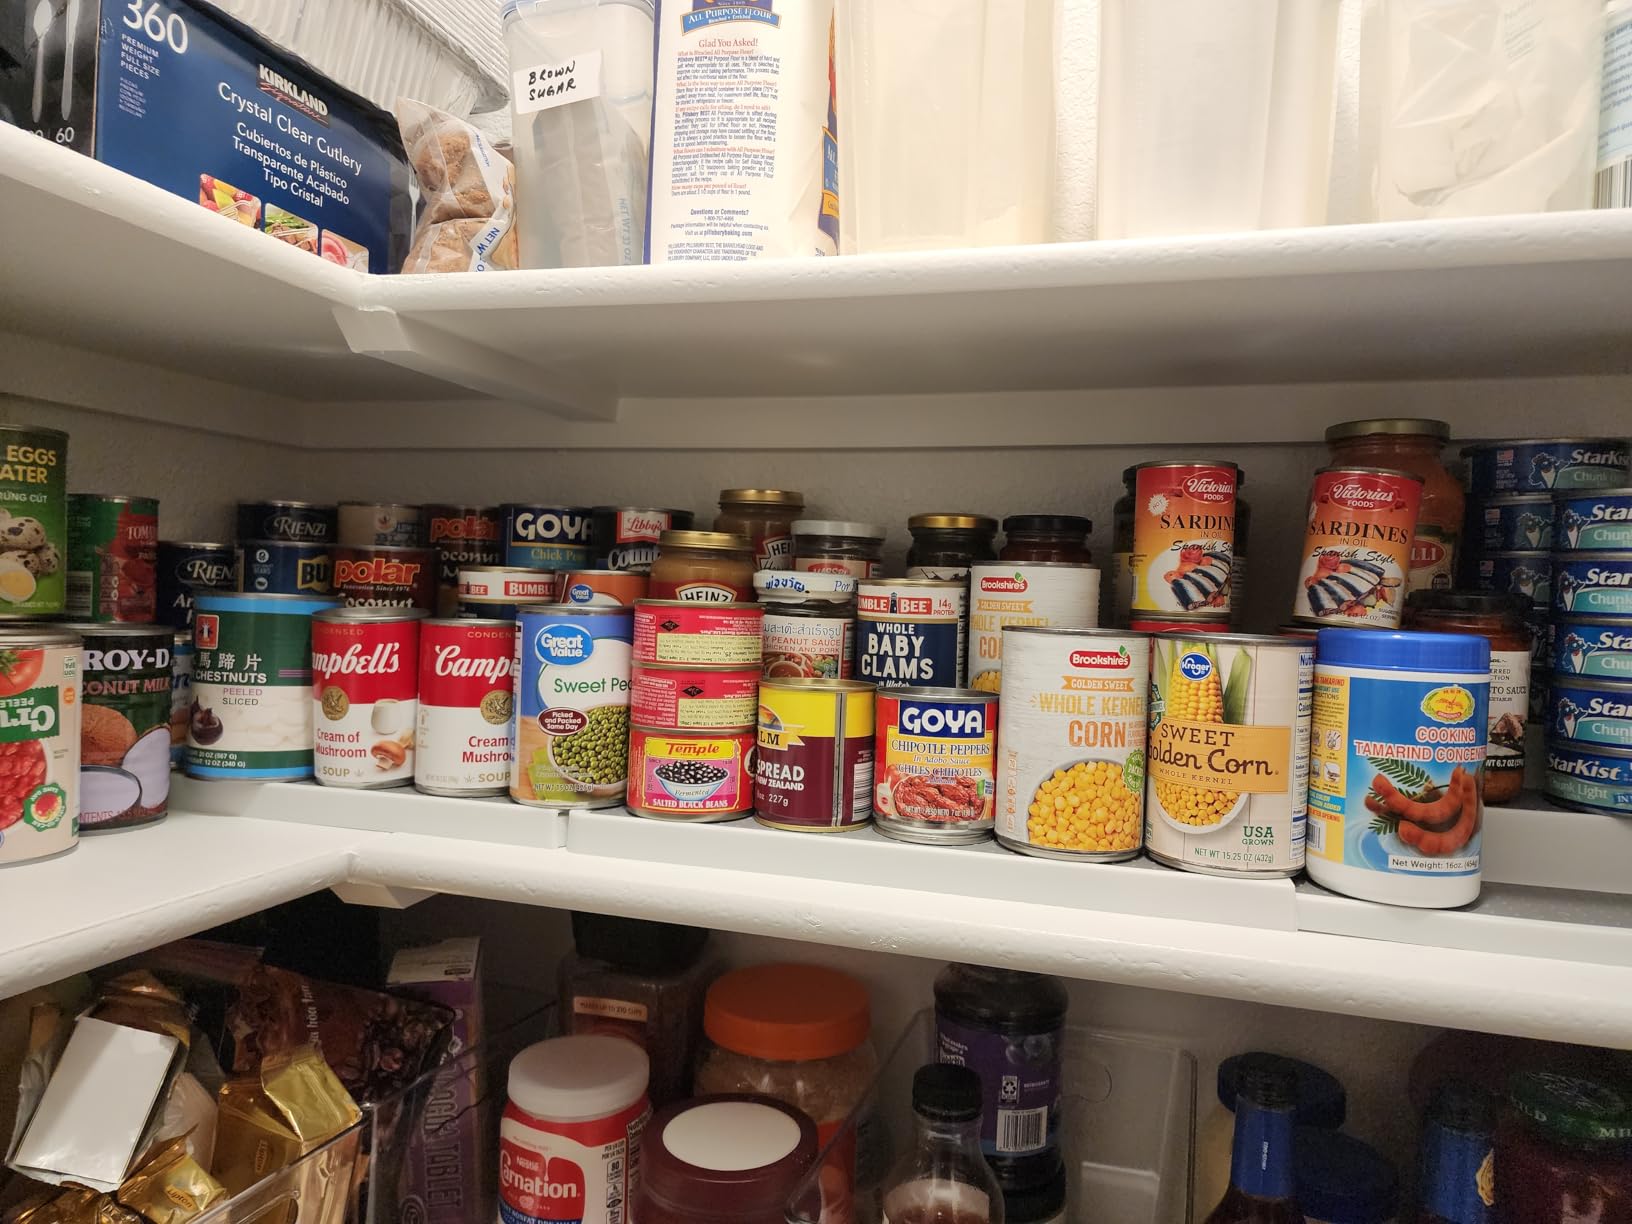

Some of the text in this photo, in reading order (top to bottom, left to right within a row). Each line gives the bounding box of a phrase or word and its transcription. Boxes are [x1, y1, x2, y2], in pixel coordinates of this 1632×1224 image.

[689, 7, 772, 24] ALL PURPOSE FLOUR
[123, 0, 188, 54] 360
[121, 33, 160, 58] PREMIUM
[698, 38, 760, 48] Glad You Asked!
[121, 42, 153, 64] WEIGHT
[120, 51, 161, 77] FULL SIZE
[120, 60, 149, 80] PIECES
[528, 60, 577, 87] BROWN
[258, 63, 328, 118] KIRKLAND
[528, 77, 577, 101] SUGAR
[56, 126, 75, 143] 60
[218, 82, 362, 177] Crystal Clear Cutlery
[237, 121, 348, 189] Cubiertos de Plástico
[232, 135, 350, 206] Transparente Acabado
[264, 167, 324, 208] Tipo Cristal
[486, 226, 500, 245] NET
[6, 444, 57, 466] EGGS
[0, 463, 48, 484] ATER
[1203, 493, 1224, 501] FOODS
[1347, 499, 1375, 508] FOODS
[1159, 513, 1235, 531] SARDIN
[1308, 519, 1409, 545] SARDINES
[1170, 540, 1217, 552] Spanish
[1339, 536, 1368, 547] IN OIL
[1311, 545, 1396, 565] Spanish Style
[186, 560, 237, 587] RIEN
[334, 557, 421, 588] polar
[1586, 567, 1632, 586] Star
[900, 598, 928, 613] BEE
[467, 631, 511, 639] CONDEN
[876, 622, 916, 635] WHOLE
[540, 632, 584, 650] Great
[764, 643, 797, 652] HICKEN
[771, 636, 841, 648] PEANUT SAUCE
[868, 632, 925, 658] BABY
[82, 649, 170, 672] ROY-D
[200, 651, 262, 672] 馬蹄片
[312, 642, 401, 680] mpbell's
[549, 646, 584, 659] Value
[434, 645, 513, 685] Camp
[861, 654, 934, 680] CLAMS
[1180, 659, 1210, 677] Kroger
[195, 670, 267, 684] CHESTNUTS
[553, 676, 633, 694] Sweet Pea
[1071, 678, 1129, 691] GOLDEN SWEET
[223, 687, 263, 696] PEELED
[222, 696, 259, 706] SLICED
[1039, 692, 1096, 716] WHOLE
[0, 705, 56, 733] Cru
[552, 711, 574, 719] Picked
[558, 717, 582, 725] Packed
[902, 707, 983, 734] GOYA
[317, 727, 361, 743] Cream of
[565, 723, 579, 731] Day
[1068, 719, 1126, 748] CORN
[1161, 722, 1235, 748] SWEET
[1416, 727, 1475, 743] COOKING
[315, 741, 367, 759] Mushroom
[468, 735, 509, 748] Cream
[665, 742, 720, 756] Temple
[891, 739, 990, 756] CHIPOTLE PEPPERS
[462, 751, 513, 763] Mushro
[1148, 736, 1202, 770] olden
[1354, 741, 1487, 762] TAMARIND CONCENT
[322, 766, 350, 777] SOUP
[757, 759, 805, 782] SPREAD
[1548, 752, 1622, 780] StarKist
[478, 771, 511, 783] SOUP
[1158, 767, 1233, 785] WHOLE KERNEL
[674, 788, 709, 797] Fermented
[768, 779, 805, 792] ZEALAND
[653, 798, 728, 808] SALTED BLACK BEANS
[768, 793, 789, 807] 227g
[1243, 824, 1274, 839] USA
[1241, 838, 1274, 846] GROWN
[1194, 846, 1274, 864] NET WT 15.25 OZ (432g)
[1392, 857, 1409, 867] Net
[1410, 859, 1444, 870] Weight:
[501, 1150, 578, 1200] Carnation
